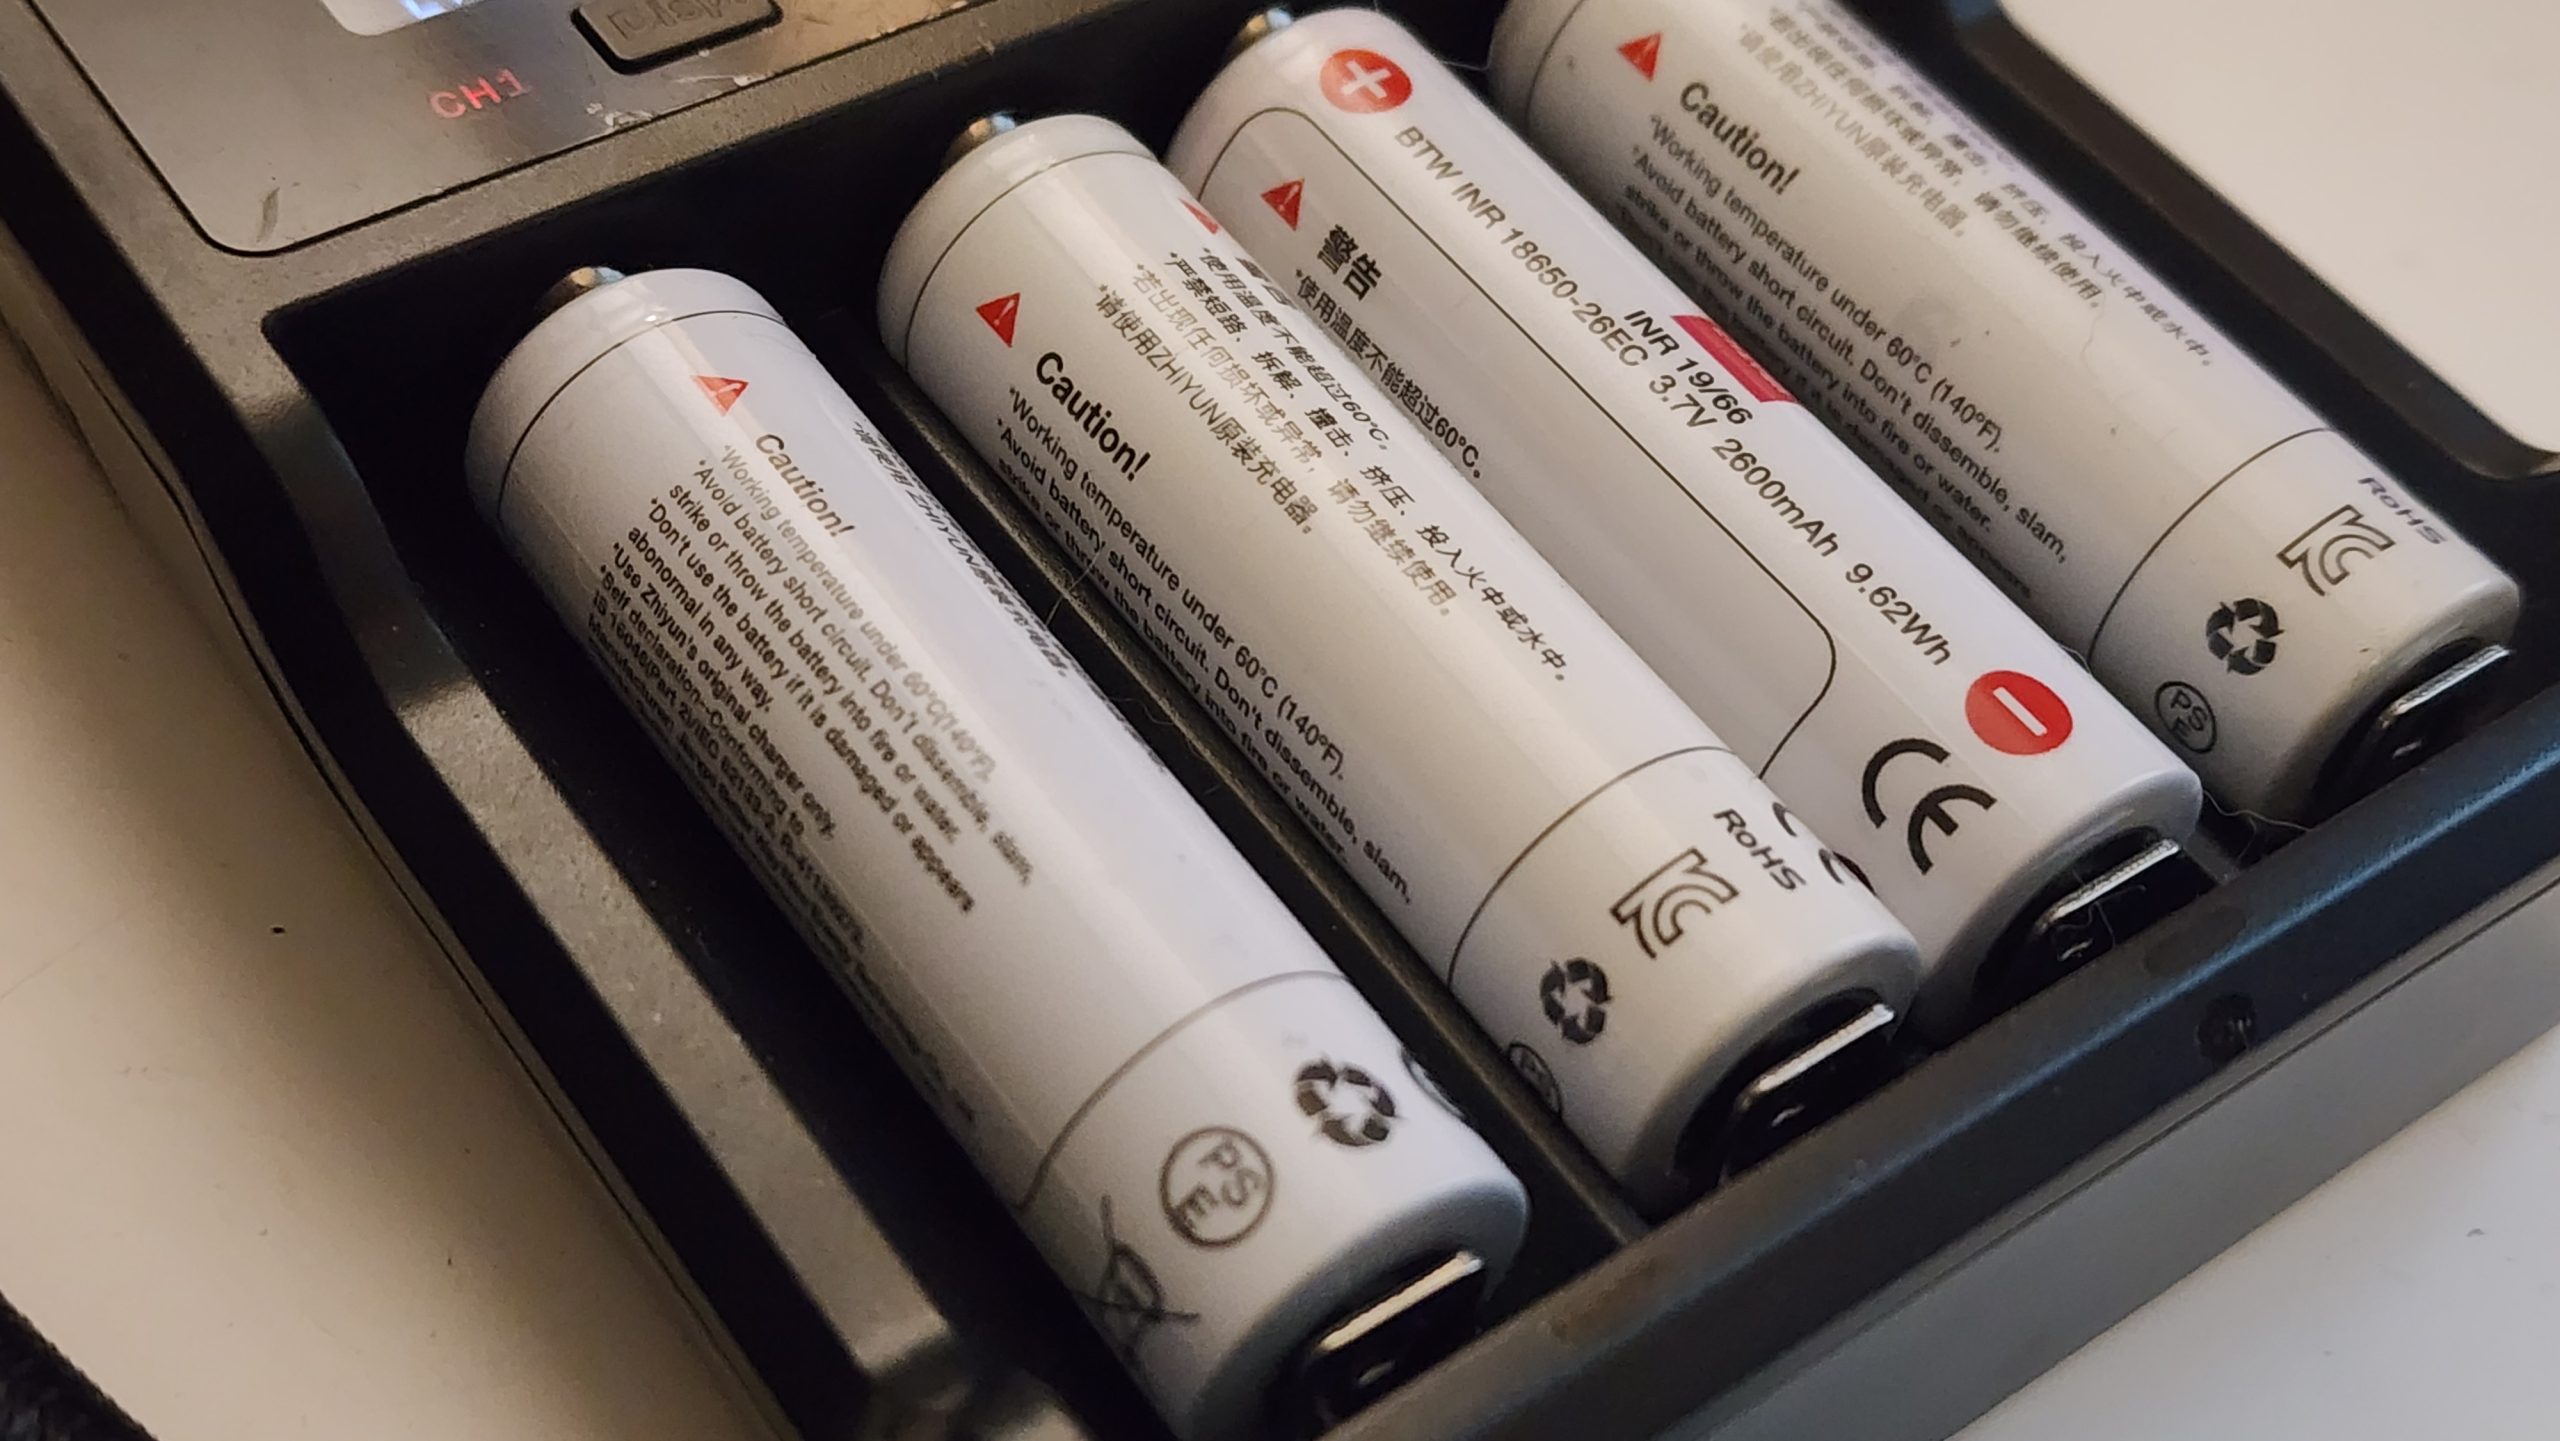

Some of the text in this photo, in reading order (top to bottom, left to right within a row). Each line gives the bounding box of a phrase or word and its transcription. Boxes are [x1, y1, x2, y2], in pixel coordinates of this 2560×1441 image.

[429, 67, 528, 121] CH1
[1680, 82, 1799, 194] Caution!
[1317, 224, 1381, 300] 警告
[1723, 187, 1828, 292] temperature
[1830, 288, 1886, 341] under
[1036, 352, 1150, 481] Caution!
[1394, 126, 1463, 179] BTW
[1452, 182, 1505, 228] INR
[1501, 228, 1648, 366] 18650-26EC
[1649, 374, 1717, 427] 3.7V
[1712, 438, 1837, 556] 2600mAh
[1845, 563, 1949, 665] 9.62Wh
[1624, 310, 1679, 355] INR
[1676, 358, 1752, 424] 19/66
[1673, 230, 1693, 251] or
[1695, 245, 1743, 300] throw
[1746, 294, 1774, 329] the
[1777, 325, 1839, 390] battery
[1841, 383, 1876, 424] into
[1880, 419, 1909, 455] fire
[1913, 453, 1935, 475] or
[1938, 474, 1990, 532] water.
[1684, 196, 1747, 264] battery
[1748, 259, 1796, 309] short
[1796, 305, 1853, 366] circuit.
[1859, 358, 1911, 415] Don't
[1912, 412, 2009, 511] dissemble,
[2015, 507, 2065, 563] slam,
[755, 434, 855, 536] Caution!
[2356, 476, 2449, 546] RoHS
[628, 527, 773, 713] abonormal in any way.
[669, 485, 709, 532] strike
[707, 532, 729, 552] or
[724, 550, 767, 601] throw
[764, 598, 791, 633] the
[787, 629, 843, 695] battery
[838, 690, 870, 731] into
[869, 729, 896, 762] fire
[894, 764, 916, 784] or
[733, 513, 787, 575] battery
[782, 576, 827, 623] short
[820, 623, 871, 683] circuit.
[868, 678, 918, 734] Don't
[776, 519, 863, 619] temperature
[859, 621, 908, 671] under
[1080, 471, 1179, 591] temperature
[1181, 588, 1234, 649] under
[1234, 645, 1278, 698] 60°C
[639, 583, 697, 661] Zhiyun's
[697, 659, 751, 725] original
[747, 723, 804, 793] charger
[686, 553, 714, 587] use
[712, 584, 737, 617] the
[735, 612, 789, 680] battery
[784, 673, 805, 694] if
[796, 688, 814, 711] it
[808, 704, 826, 728] is
[824, 728, 899, 813] damaged
[892, 813, 915, 834] or
[1044, 510, 1060, 533] or
[1064, 531, 1109, 589] throw
[1113, 585, 1145, 624] the
[1142, 618, 1201, 694] battery
[1204, 689, 1236, 735] into
[1240, 732, 1267, 771] fire
[1271, 771, 1291, 794] or
[1294, 796, 1346, 862] water.
[1048, 477, 1105, 553] battery
[1108, 550, 1151, 606] short
[1154, 603, 1208, 673] circuit.
[1214, 666, 1262, 730] Don't
[1264, 728, 1357, 844] dissemble,
[1363, 840, 1410, 904] slam,
[1712, 807, 1806, 891] RoHS
[1860, 737, 1998, 876] CE
